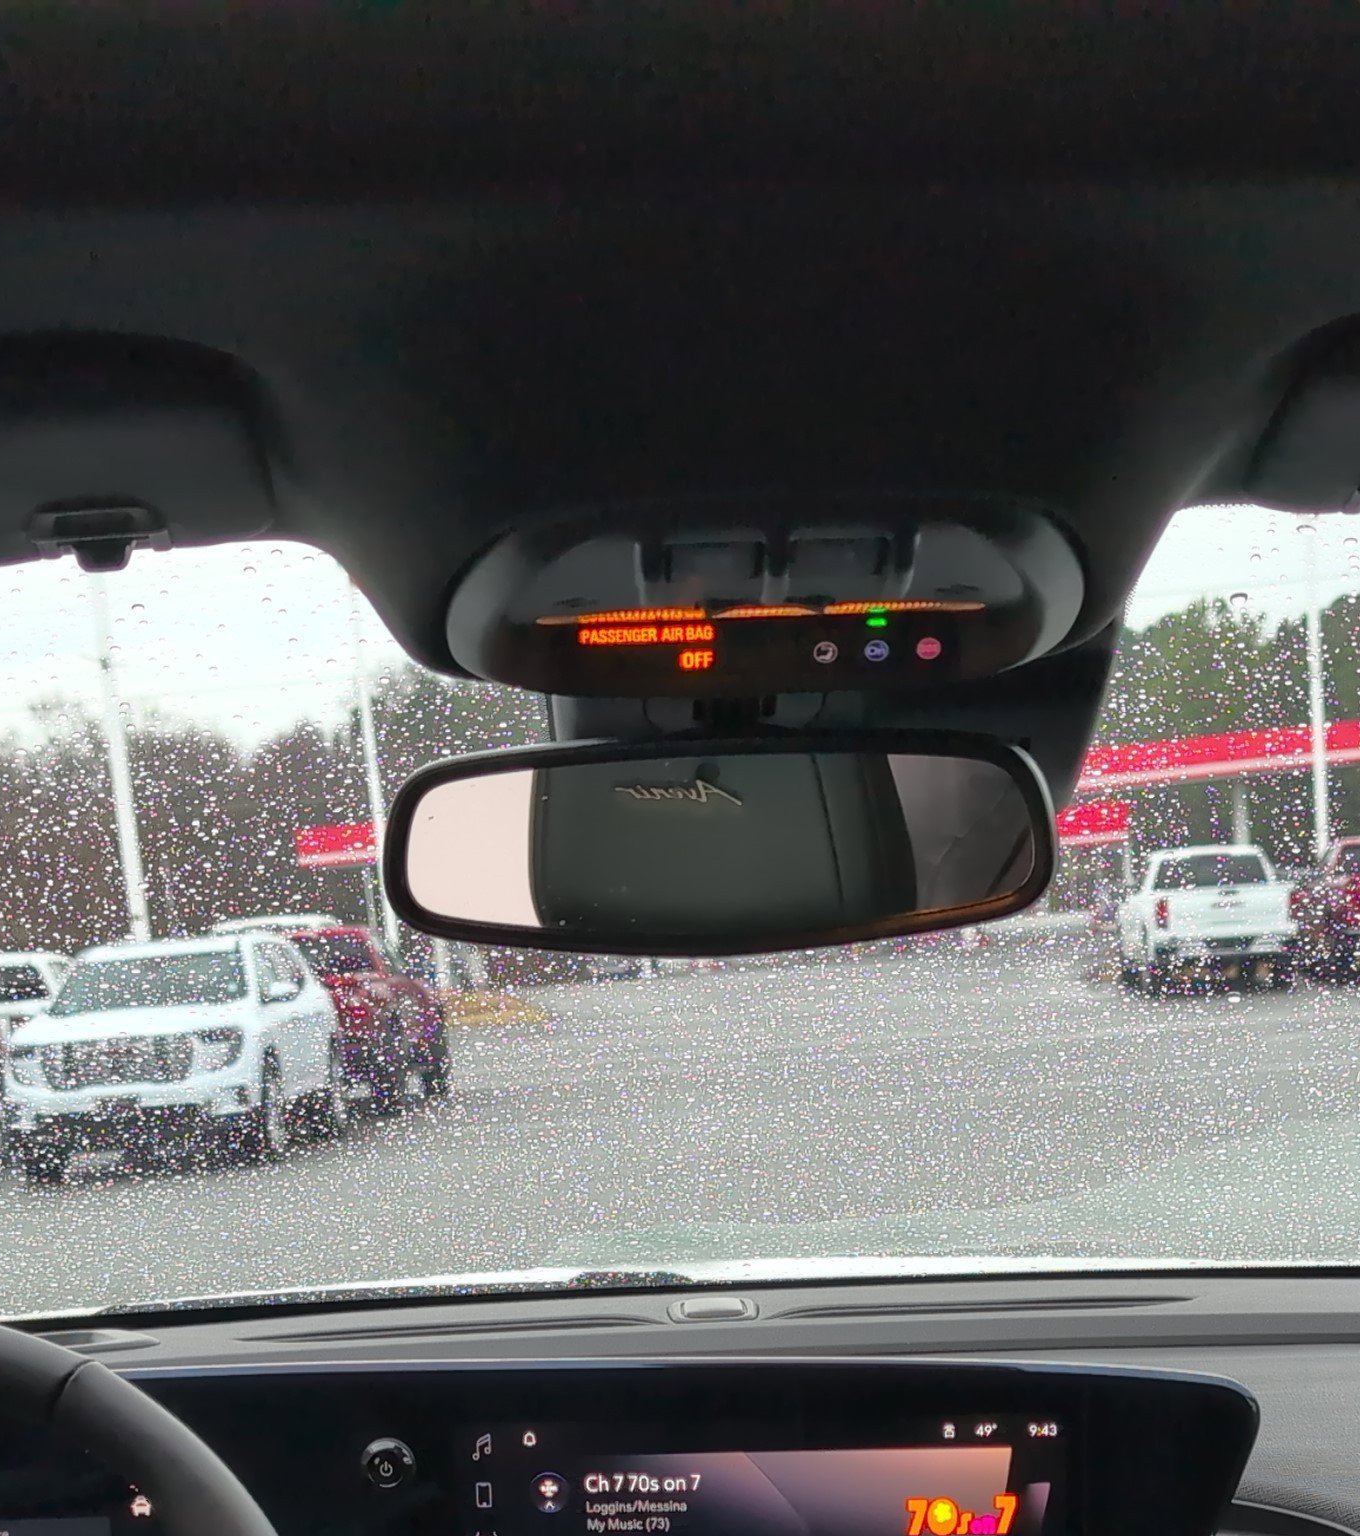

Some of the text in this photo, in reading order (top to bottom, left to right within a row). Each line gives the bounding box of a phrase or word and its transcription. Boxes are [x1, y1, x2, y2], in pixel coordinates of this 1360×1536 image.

[579, 624, 715, 644] PASSENGER AIR BAG
[679, 651, 714, 670] OFF
[1028, 1422, 1058, 1437] 9:43
[585, 1474, 702, 1493] Ch 7 70s on 7
[585, 1500, 688, 1515] Loggins/Messina
[587, 1517, 670, 1533] My Music (73)
